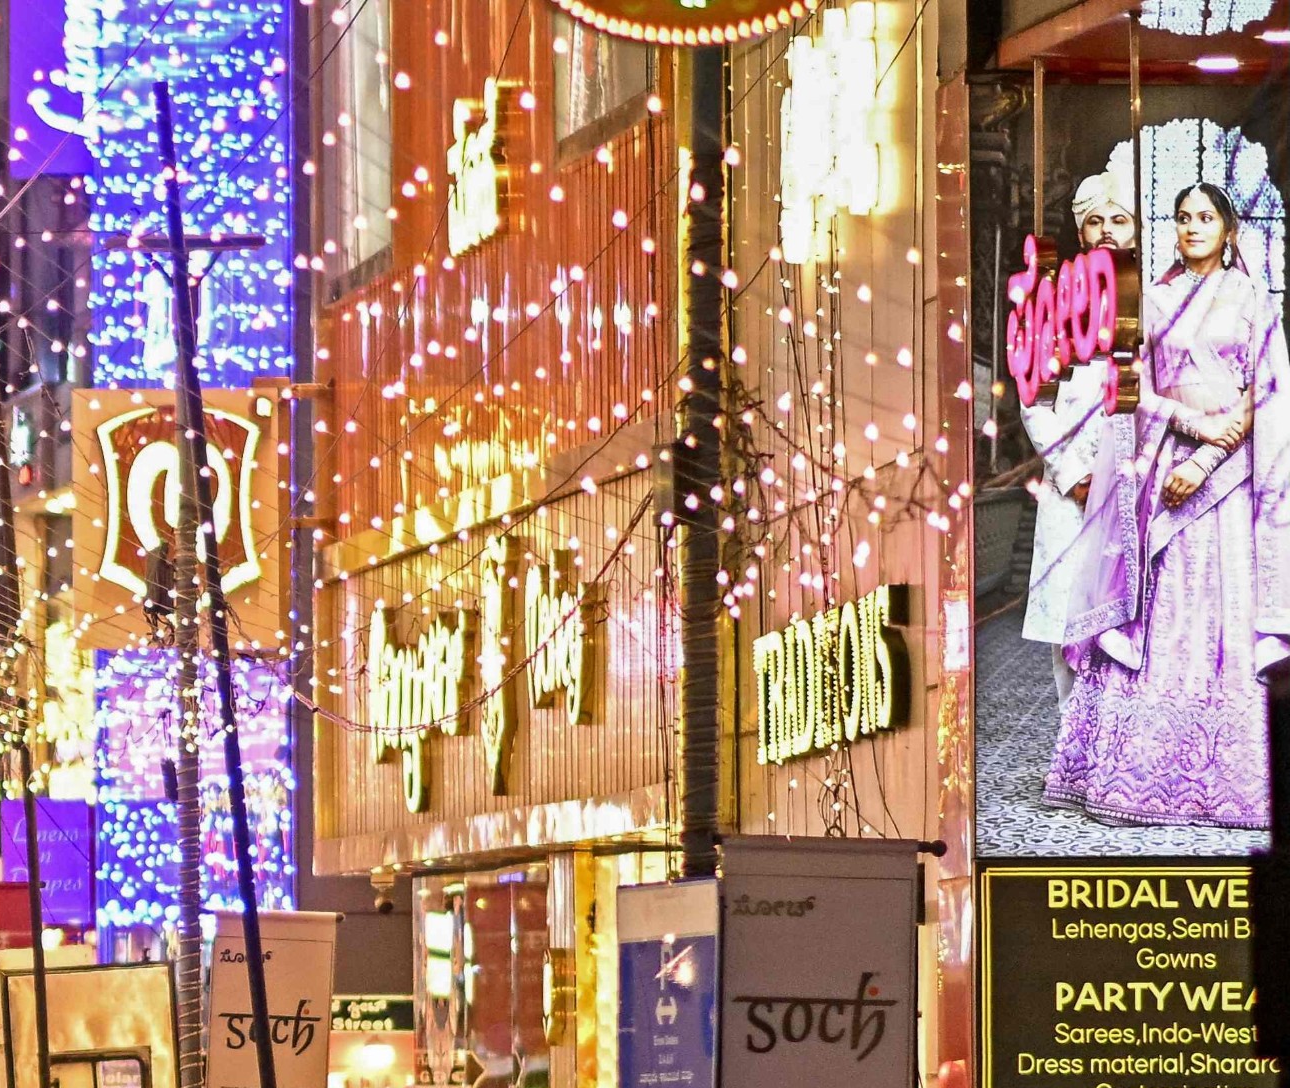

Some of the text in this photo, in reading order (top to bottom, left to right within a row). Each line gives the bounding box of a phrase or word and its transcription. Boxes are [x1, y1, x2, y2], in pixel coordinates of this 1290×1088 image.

[753, 584, 892, 764] TRADITIONS
[12, 817, 79, 841] Lnens
[1048, 879, 1250, 908] BRIDAL WE
[1051, 917, 1228, 943] Lehengas,Semi
[1136, 948, 1217, 969] Gowns
[1055, 981, 1173, 1012] PARTY
[332, 1017, 394, 1031] Street
[731, 972, 898, 1062] soch
[1054, 1022, 1258, 1045] Sarees,Indo-West
[1018, 1053, 1083, 1074] Dress
